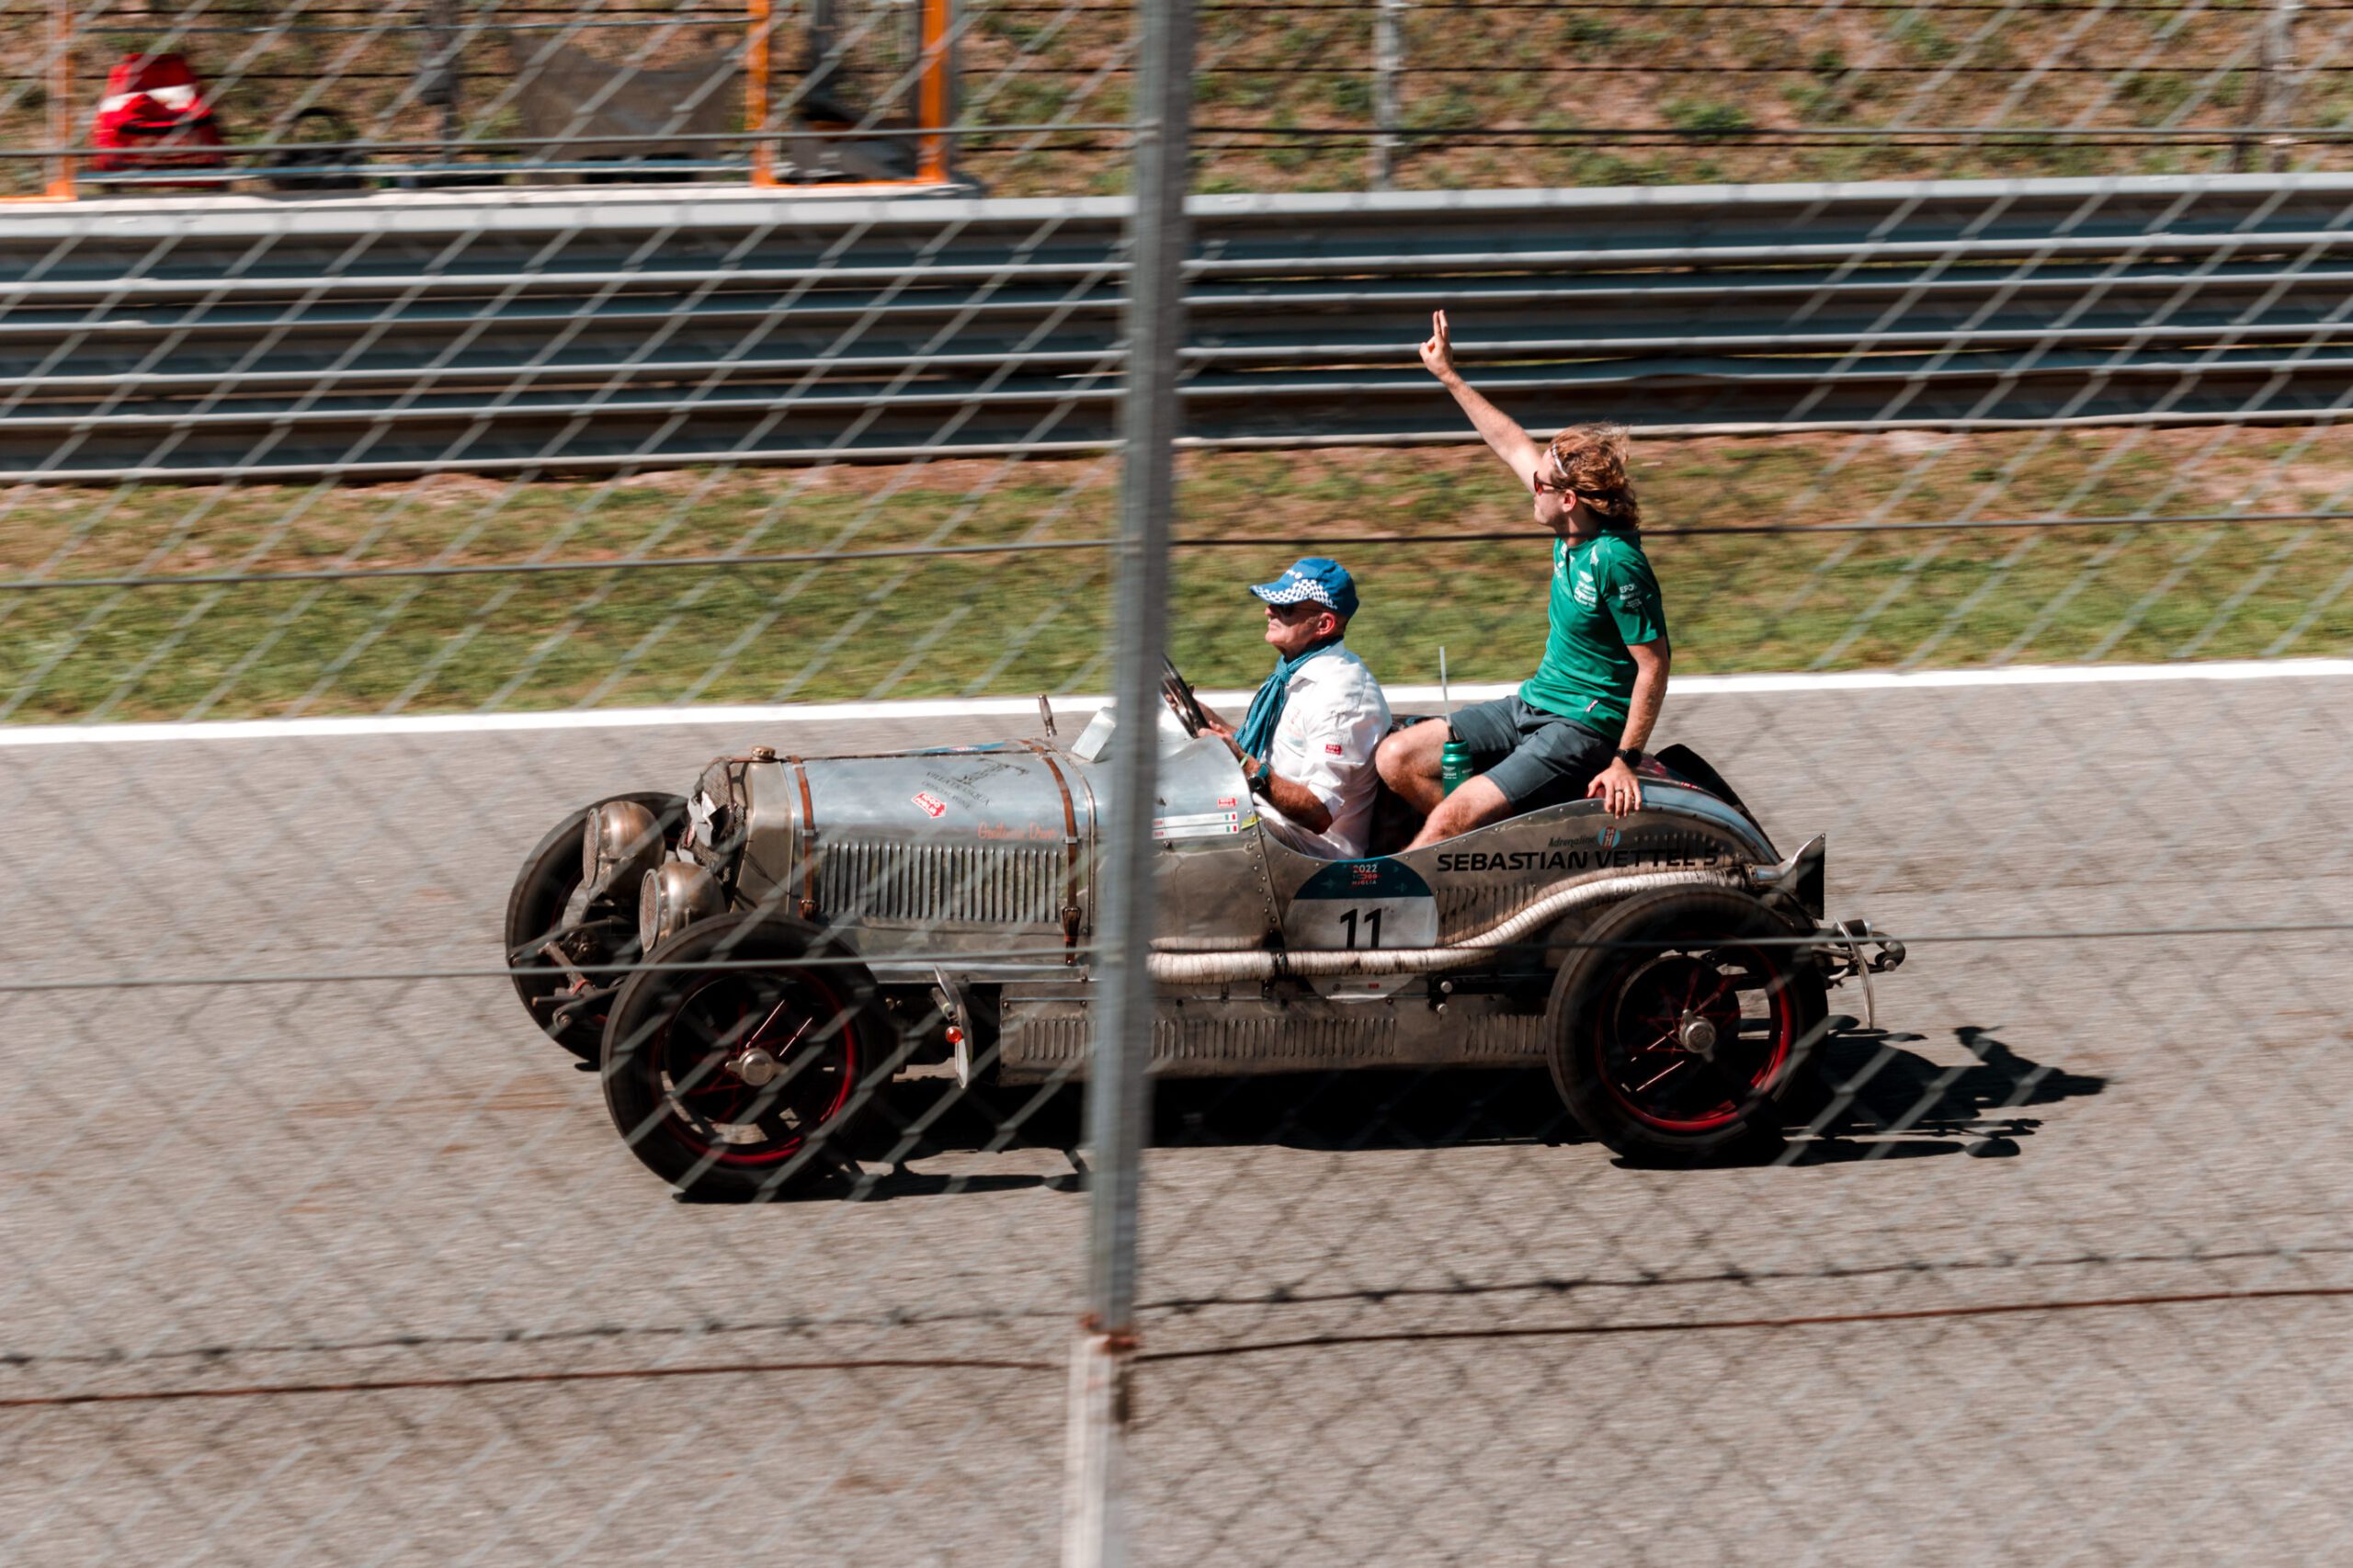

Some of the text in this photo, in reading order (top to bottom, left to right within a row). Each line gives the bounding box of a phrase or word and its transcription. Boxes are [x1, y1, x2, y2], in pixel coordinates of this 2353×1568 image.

[1352, 864, 1378, 873] 2022
[1437, 852, 1588, 871] SEBASTIAN
[1595, 848, 1696, 868] VETTEL
[1339, 908, 1382, 949] 11
